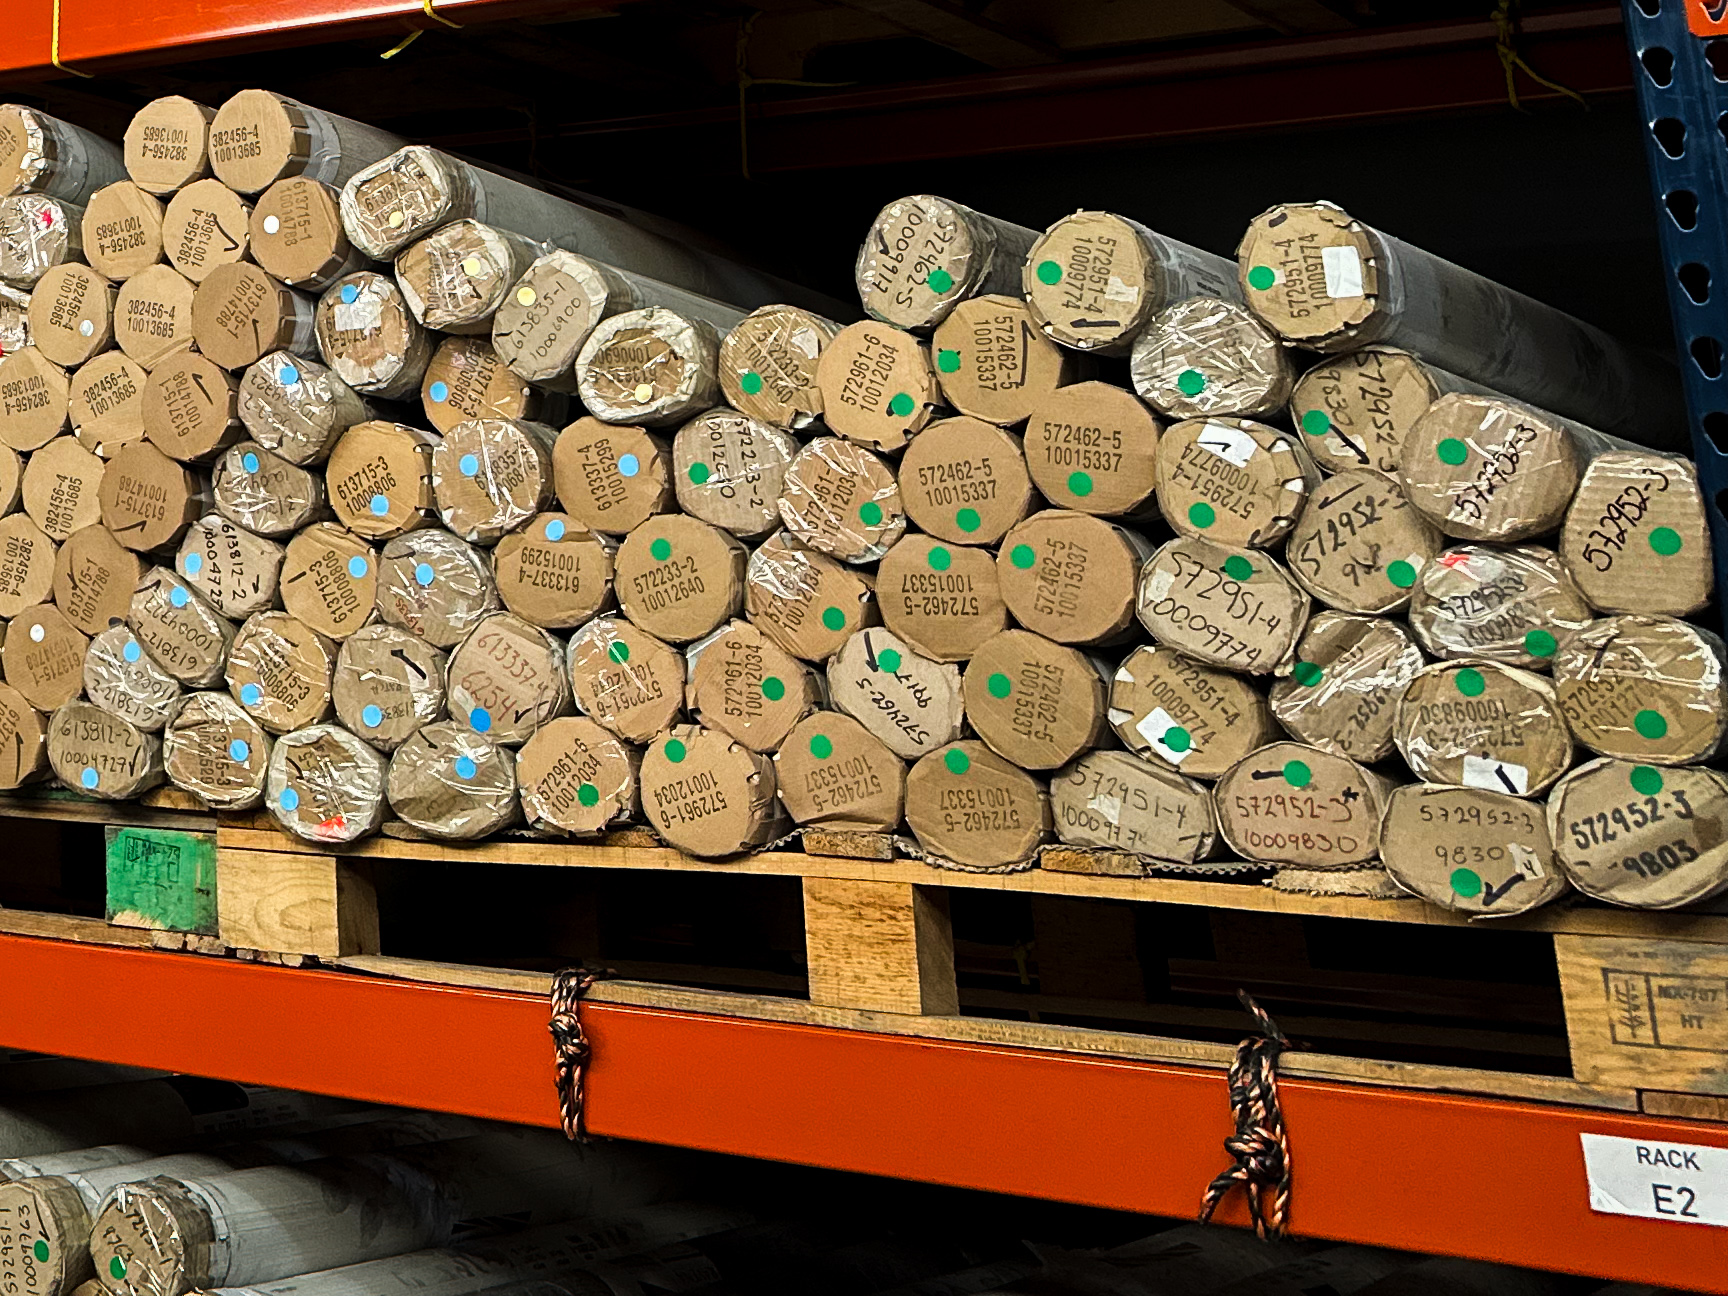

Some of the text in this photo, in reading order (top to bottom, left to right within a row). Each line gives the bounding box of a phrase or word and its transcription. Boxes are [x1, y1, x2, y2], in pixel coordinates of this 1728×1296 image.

[143, 126, 188, 143] 10013685
[212, 124, 259, 147] 382456-4
[293, 182, 312, 241] 613715-1
[1062, 237, 1091, 311] 10009774
[1092, 236, 1117, 314] 572951-4
[1274, 239, 1310, 318] 572951-4
[1299, 232, 1333, 311] 10009774
[128, 300, 175, 320] 382456-4
[512, 281, 566, 349] 613835-1
[529, 297, 581, 360] 10006900
[127, 320, 174, 338] 10013685
[841, 334, 880, 405] 572961-6
[974, 319, 997, 392] 10015337
[995, 316, 1021, 390] 572462-5
[1044, 423, 1121, 450] 572462-5
[336, 456, 389, 499] 613715-3
[919, 458, 993, 486] 572462-5
[1044, 446, 1123, 472] 10015337
[925, 479, 997, 507] 10015337
[1583, 468, 1669, 572] 572952-3
[11, 538, 33, 597] 382456-4
[222, 524, 247, 602] 613812-2
[521, 546, 580, 572] 10015299
[634, 557, 698, 593] 572233-2
[1036, 539, 1065, 615] 572462-5
[519, 567, 580, 592] 613337-4
[902, 574, 972, 593] 10015337
[461, 670, 517, 722] 6254
[1168, 653, 1241, 726] 572951-4
[1145, 674, 1216, 746] 10009774
[60, 720, 133, 747] 613812-2
[654, 770, 718, 806] 10012034
[811, 775, 882, 813] 572462-5
[660, 791, 728, 828] 572961-6
[945, 809, 1021, 832] 572462-5
[1420, 806, 1534, 834] 572952-3
[1572, 790, 1693, 850] 572952-3
[1436, 845, 1504, 866] 9830
[1680, 1014, 1704, 1029] HT
[1637, 1146, 1700, 1171] RACK
[1652, 1183, 1698, 1217] E2
